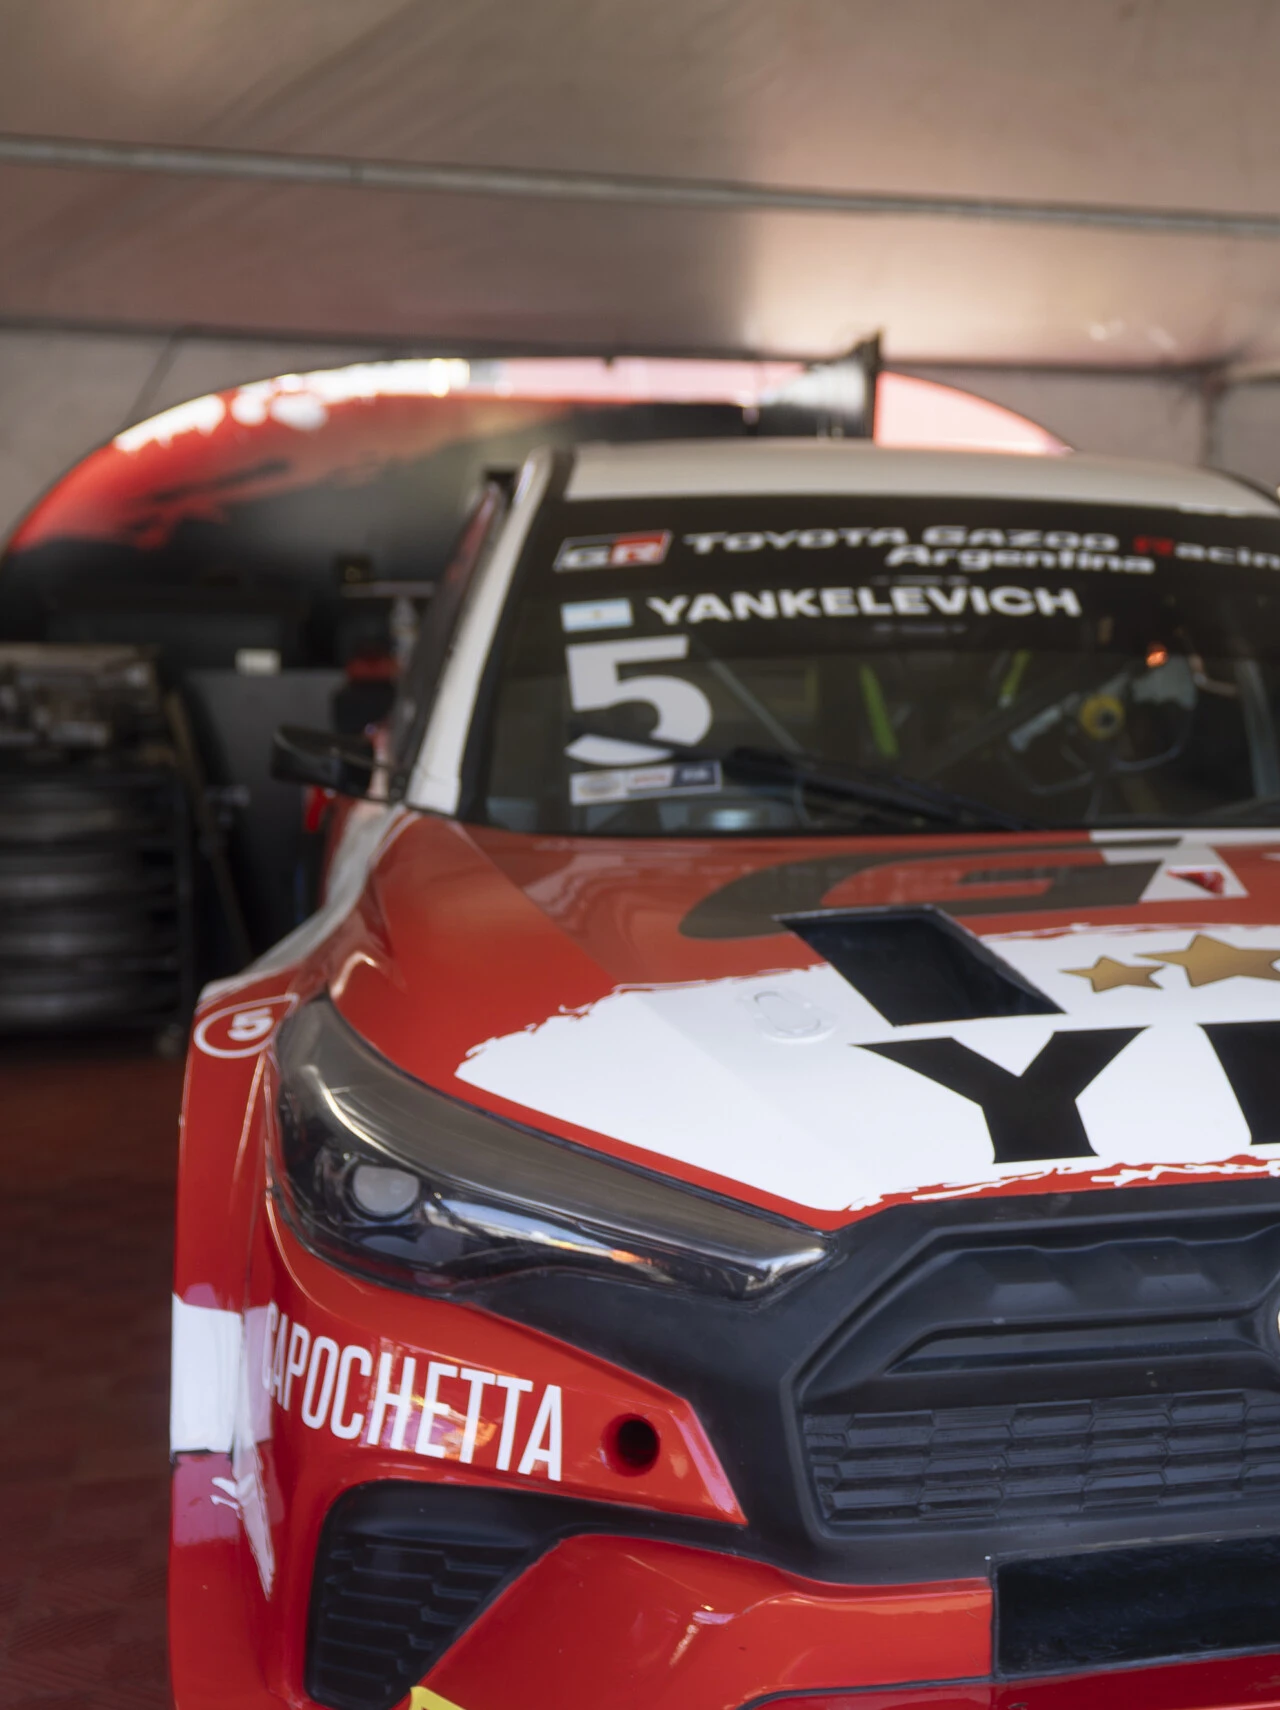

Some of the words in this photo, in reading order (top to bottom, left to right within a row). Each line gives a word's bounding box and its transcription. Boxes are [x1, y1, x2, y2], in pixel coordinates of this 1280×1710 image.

[559, 540, 664, 569] GR
[683, 527, 909, 555] TOYOTA
[921, 525, 1119, 552] GAZOO
[885, 544, 1156, 574] Argentina
[646, 585, 1082, 625] YANKELEVICH
[564, 634, 712, 767] 5
[227, 1006, 274, 1042] 5
[261, 1301, 562, 1482] CAPOCHETTA
